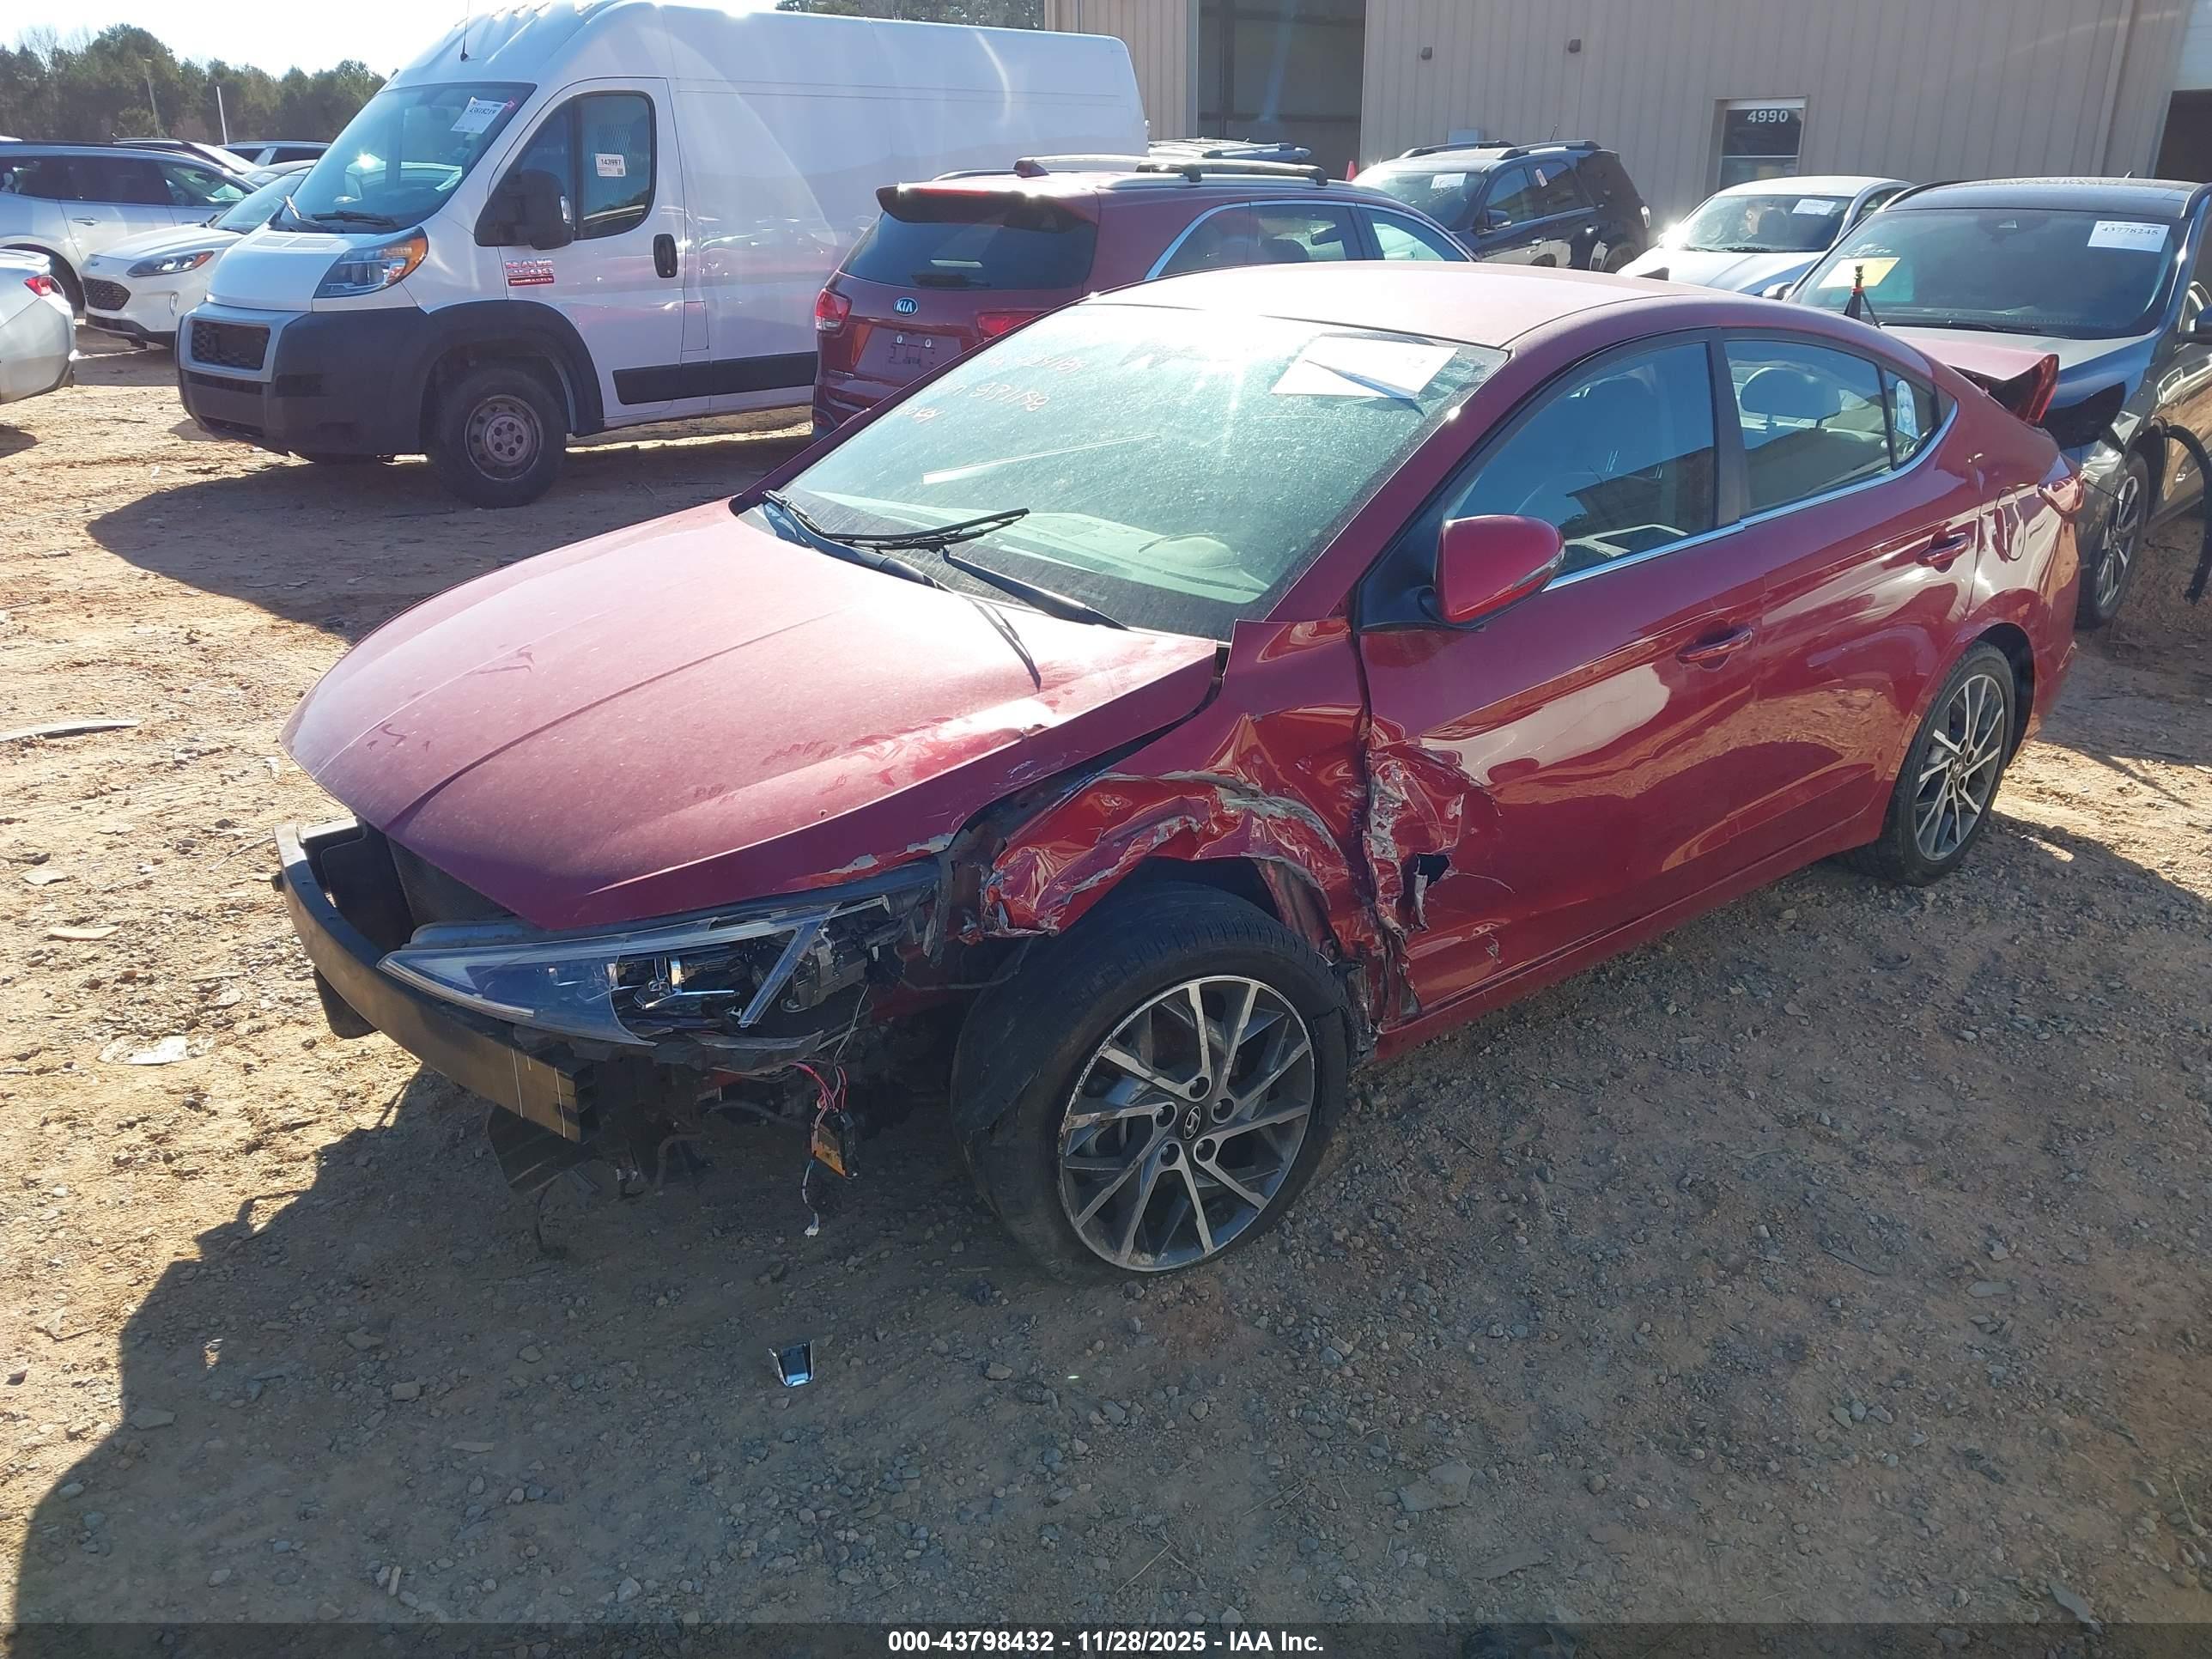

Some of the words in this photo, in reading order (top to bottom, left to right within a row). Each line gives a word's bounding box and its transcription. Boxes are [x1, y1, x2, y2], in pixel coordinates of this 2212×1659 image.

[1747, 109, 1789, 123] 4990
[2101, 226, 2159, 235] 43778245
[505, 260, 553, 269] RAM
[896, 301, 914, 313] KIA
